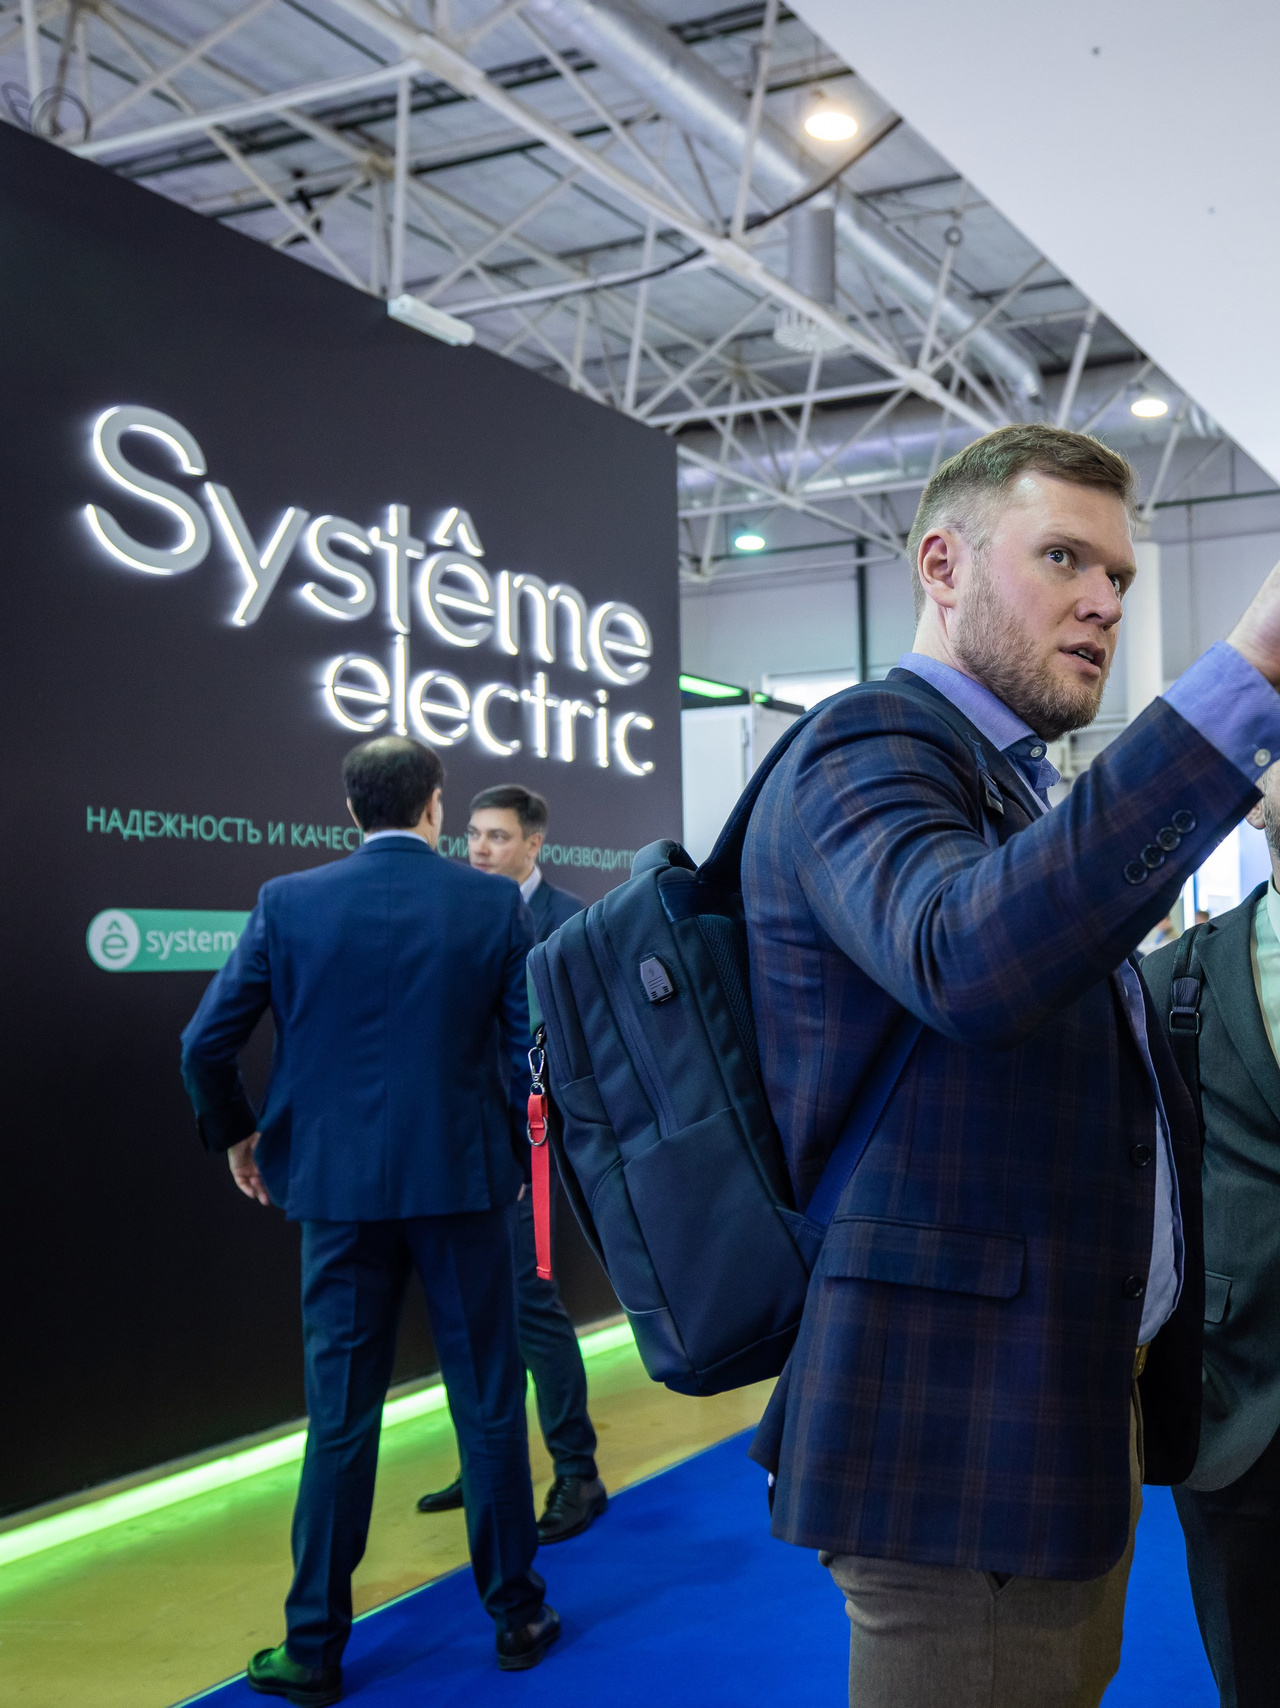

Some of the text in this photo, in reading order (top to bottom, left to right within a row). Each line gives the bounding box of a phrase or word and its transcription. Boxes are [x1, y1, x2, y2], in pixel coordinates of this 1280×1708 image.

[85, 405, 653, 684] Systême
[325, 634, 655, 775] electric
[86, 806, 262, 844] НАДЕЖНОСТЬ
[267, 821, 285, 845] И
[145, 928, 239, 960] system
